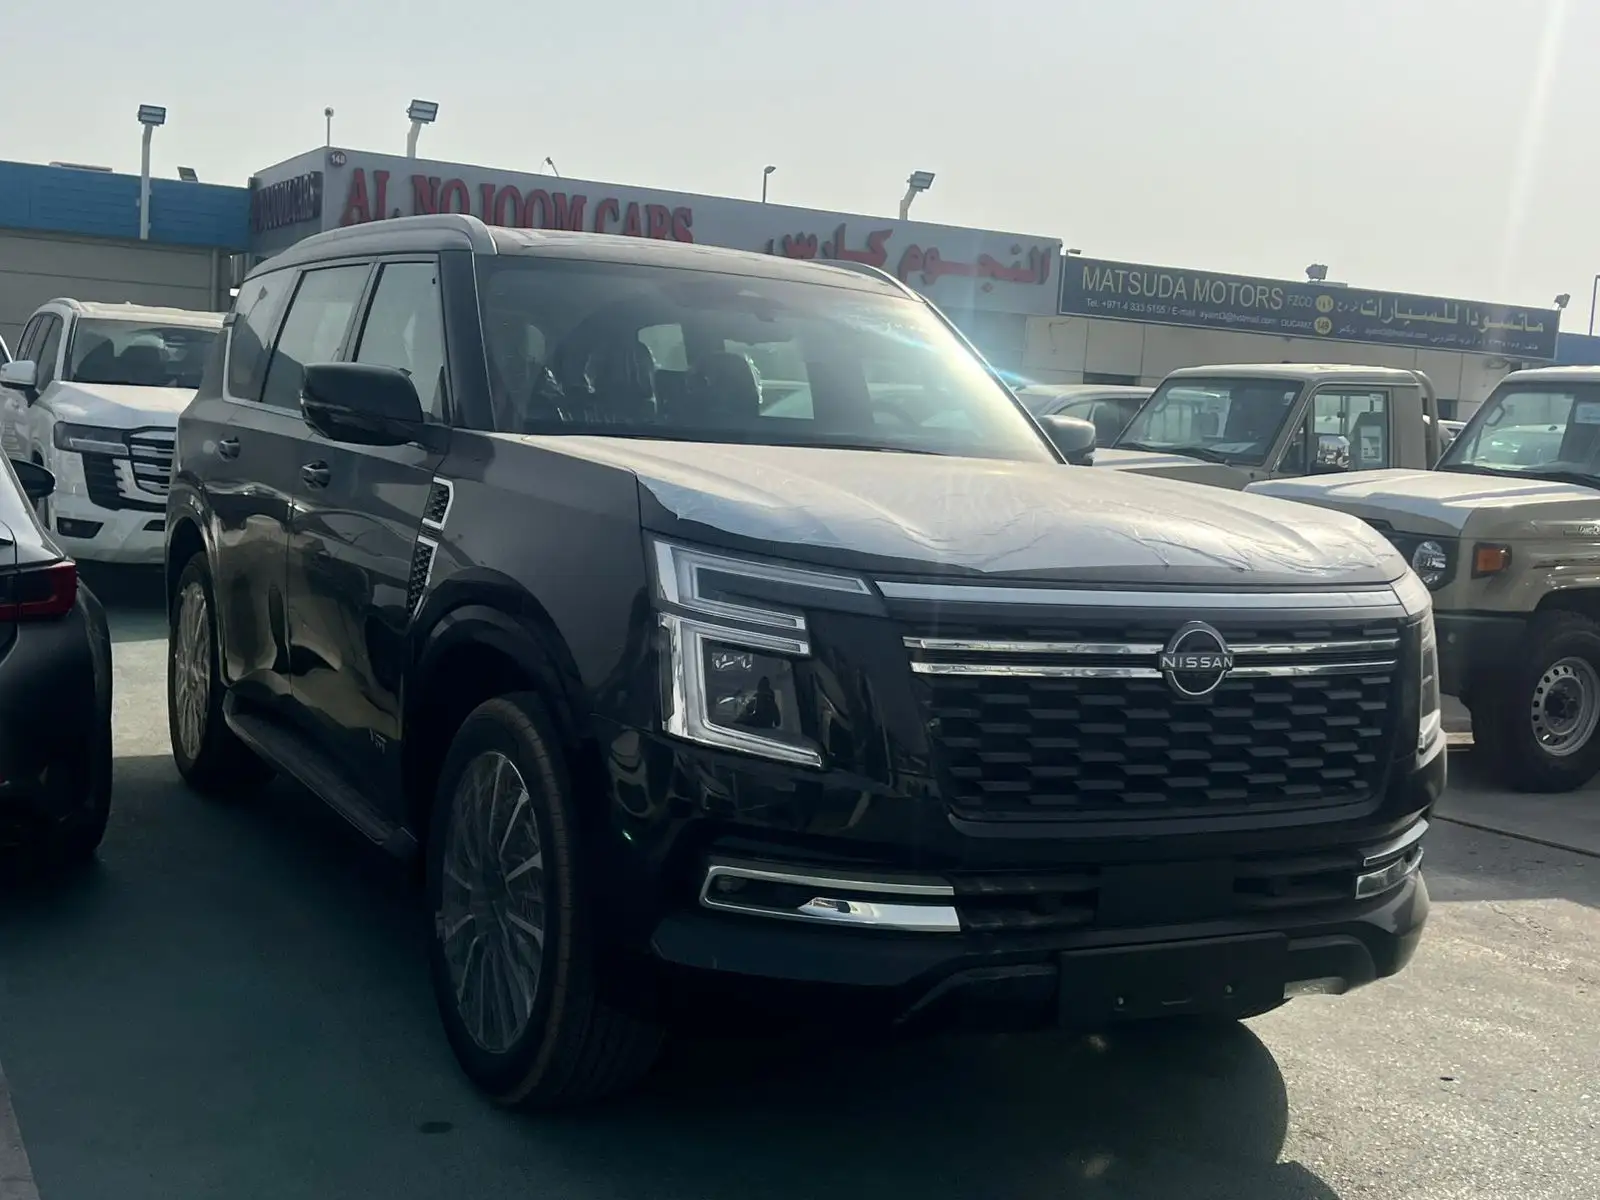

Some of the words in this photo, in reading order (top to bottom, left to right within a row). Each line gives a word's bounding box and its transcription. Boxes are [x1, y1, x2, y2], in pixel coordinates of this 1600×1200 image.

[1082, 266, 1188, 301] MATSUDA
[1193, 279, 1284, 310] MOTORS
[1161, 656, 1233, 669] NISSAN
